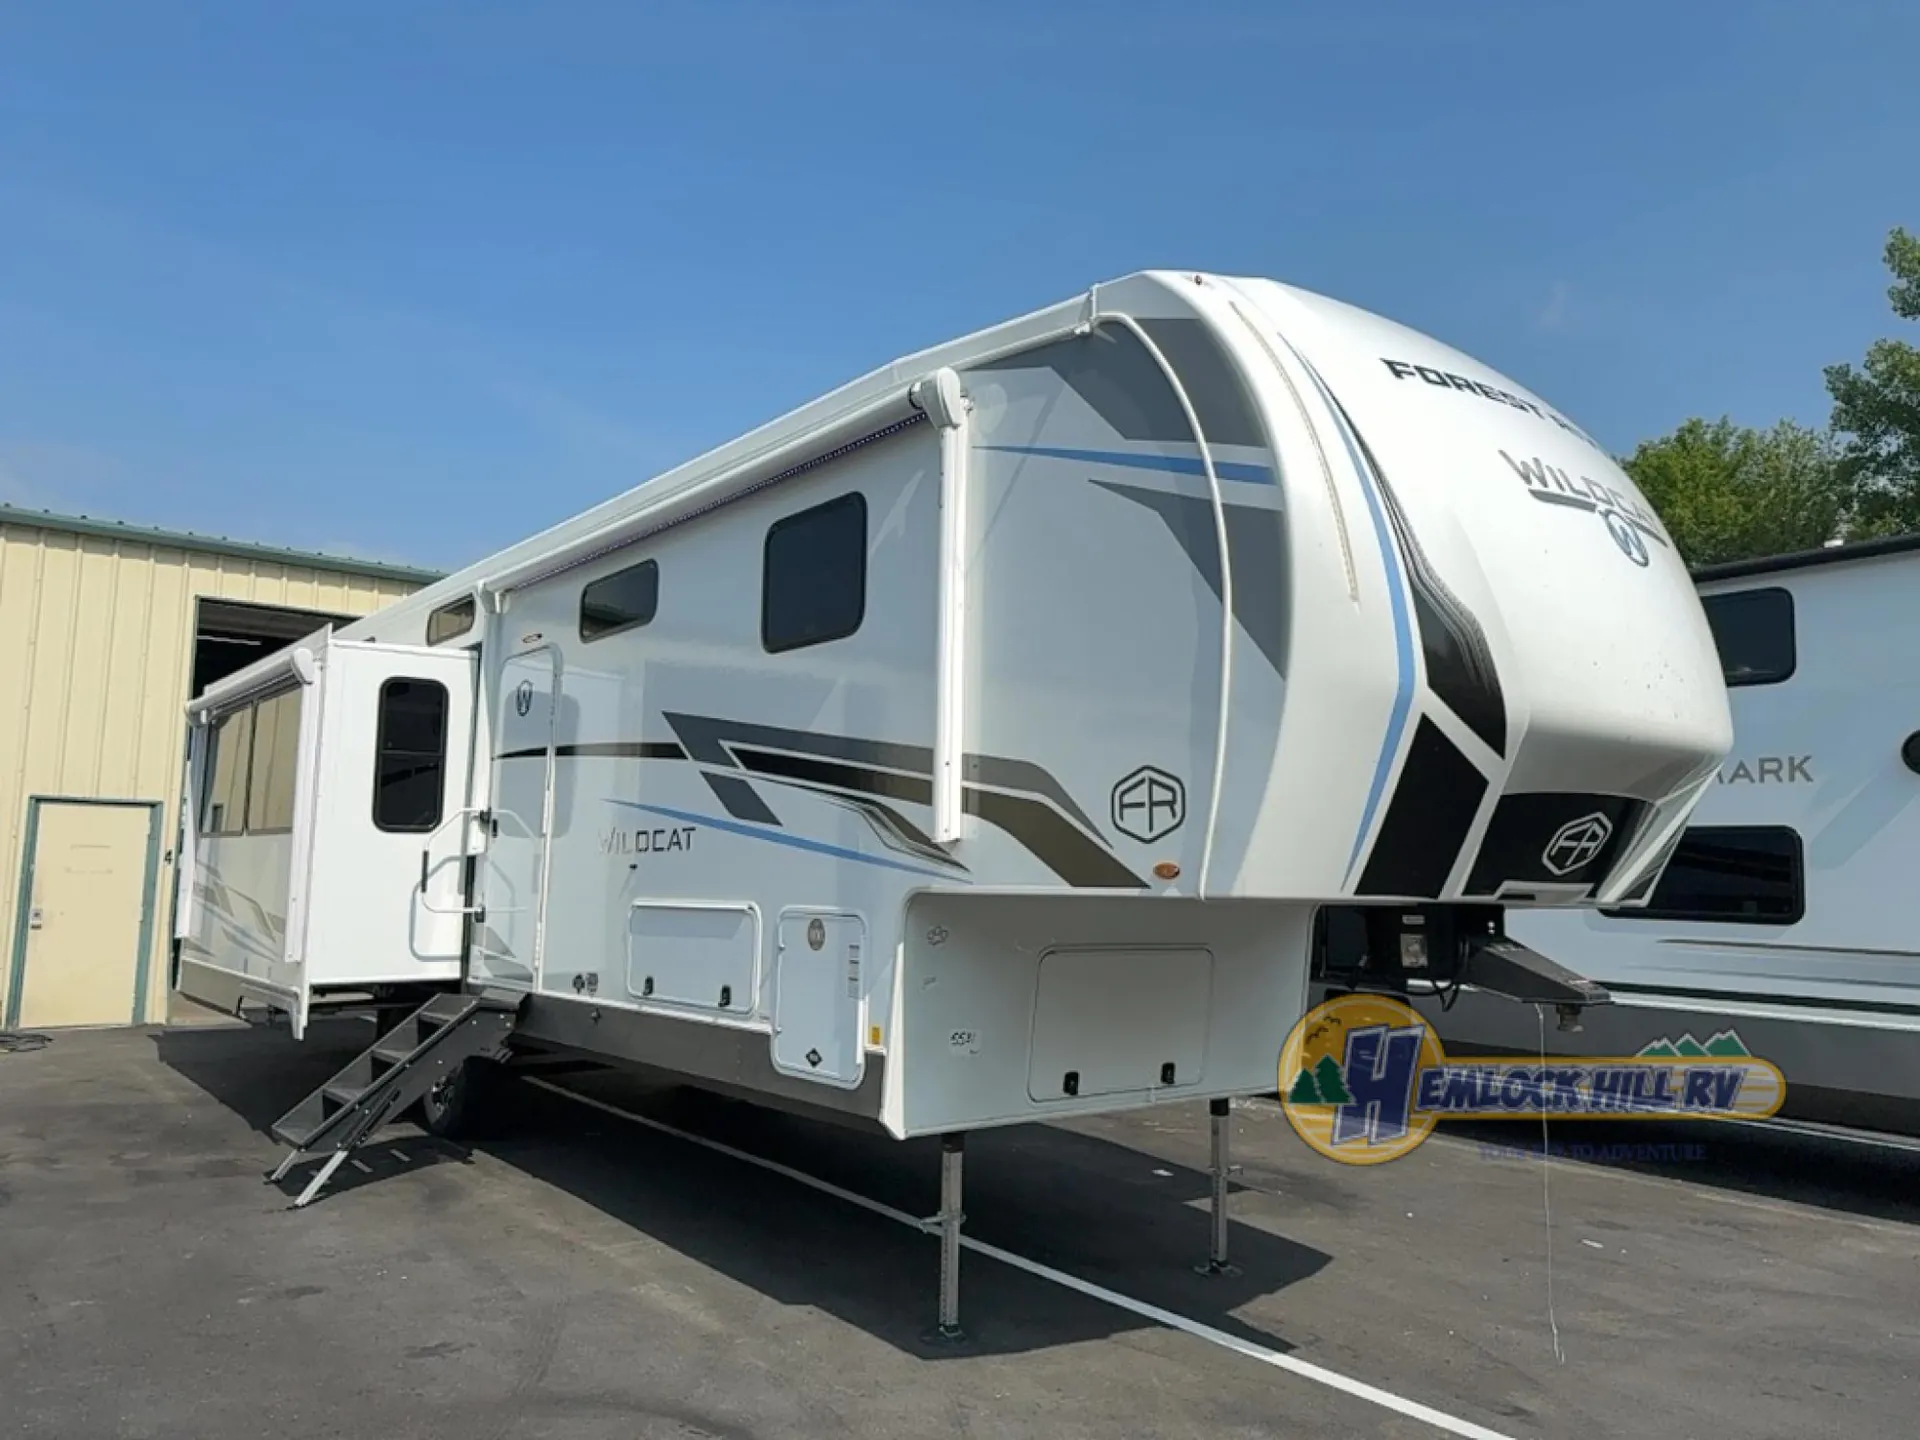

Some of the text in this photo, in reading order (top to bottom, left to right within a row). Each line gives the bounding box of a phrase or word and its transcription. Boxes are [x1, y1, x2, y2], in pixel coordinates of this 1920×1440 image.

[1380, 357, 1546, 420] FOREST
[1716, 755, 1814, 784] ARK
[599, 827, 696, 855] WILDCAT
